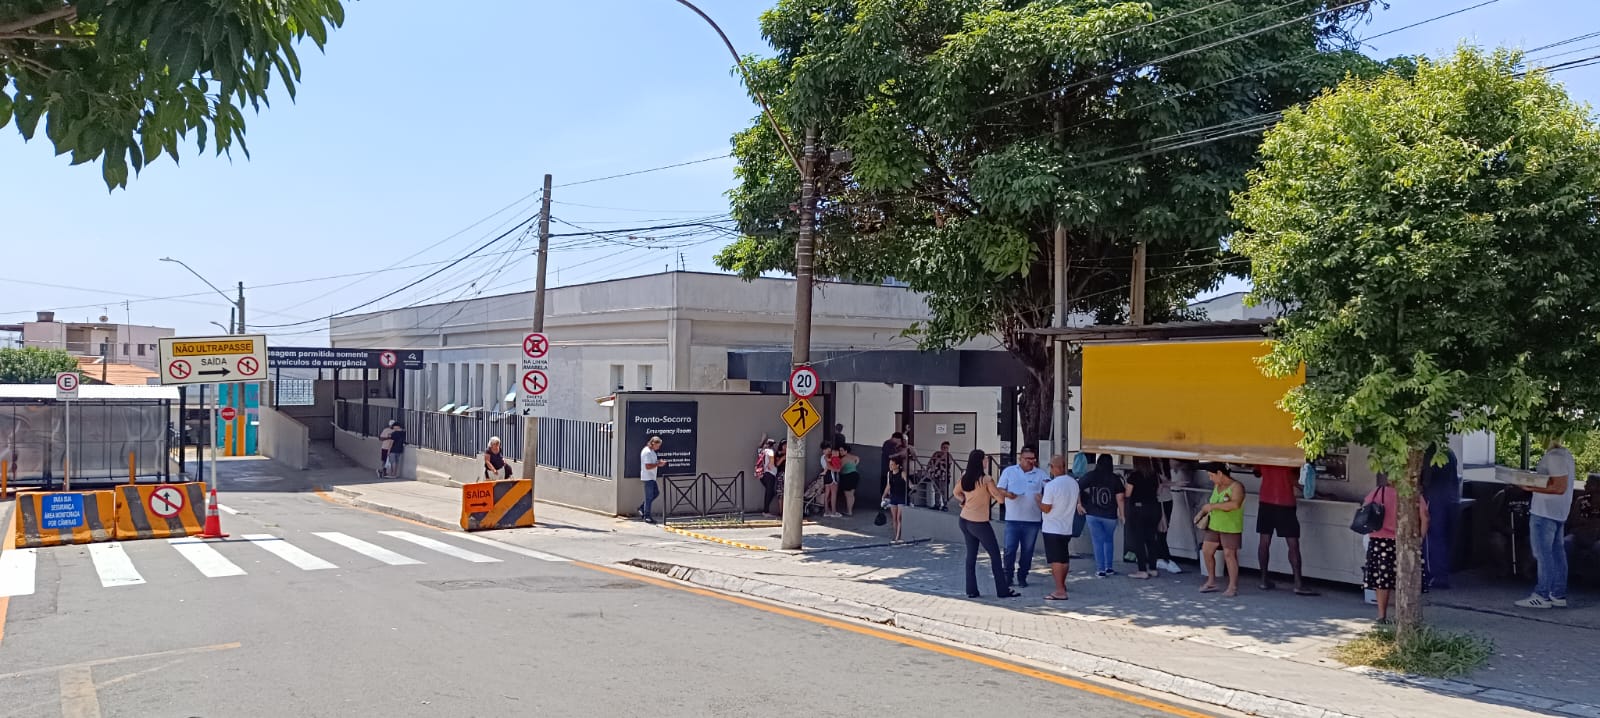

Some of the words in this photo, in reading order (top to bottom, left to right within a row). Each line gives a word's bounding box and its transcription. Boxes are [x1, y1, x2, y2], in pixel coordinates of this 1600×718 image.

[175, 344, 195, 353] NÃO
[196, 343, 251, 352] ULTRAPASSE
[298, 350, 335, 358] permitida
[201, 357, 228, 366] SAÍDA
[64, 377, 72, 387] E
[797, 374, 812, 388] 20
[634, 415, 692, 423] Pronto-Socorro
[466, 489, 491, 499] SAÍDA
